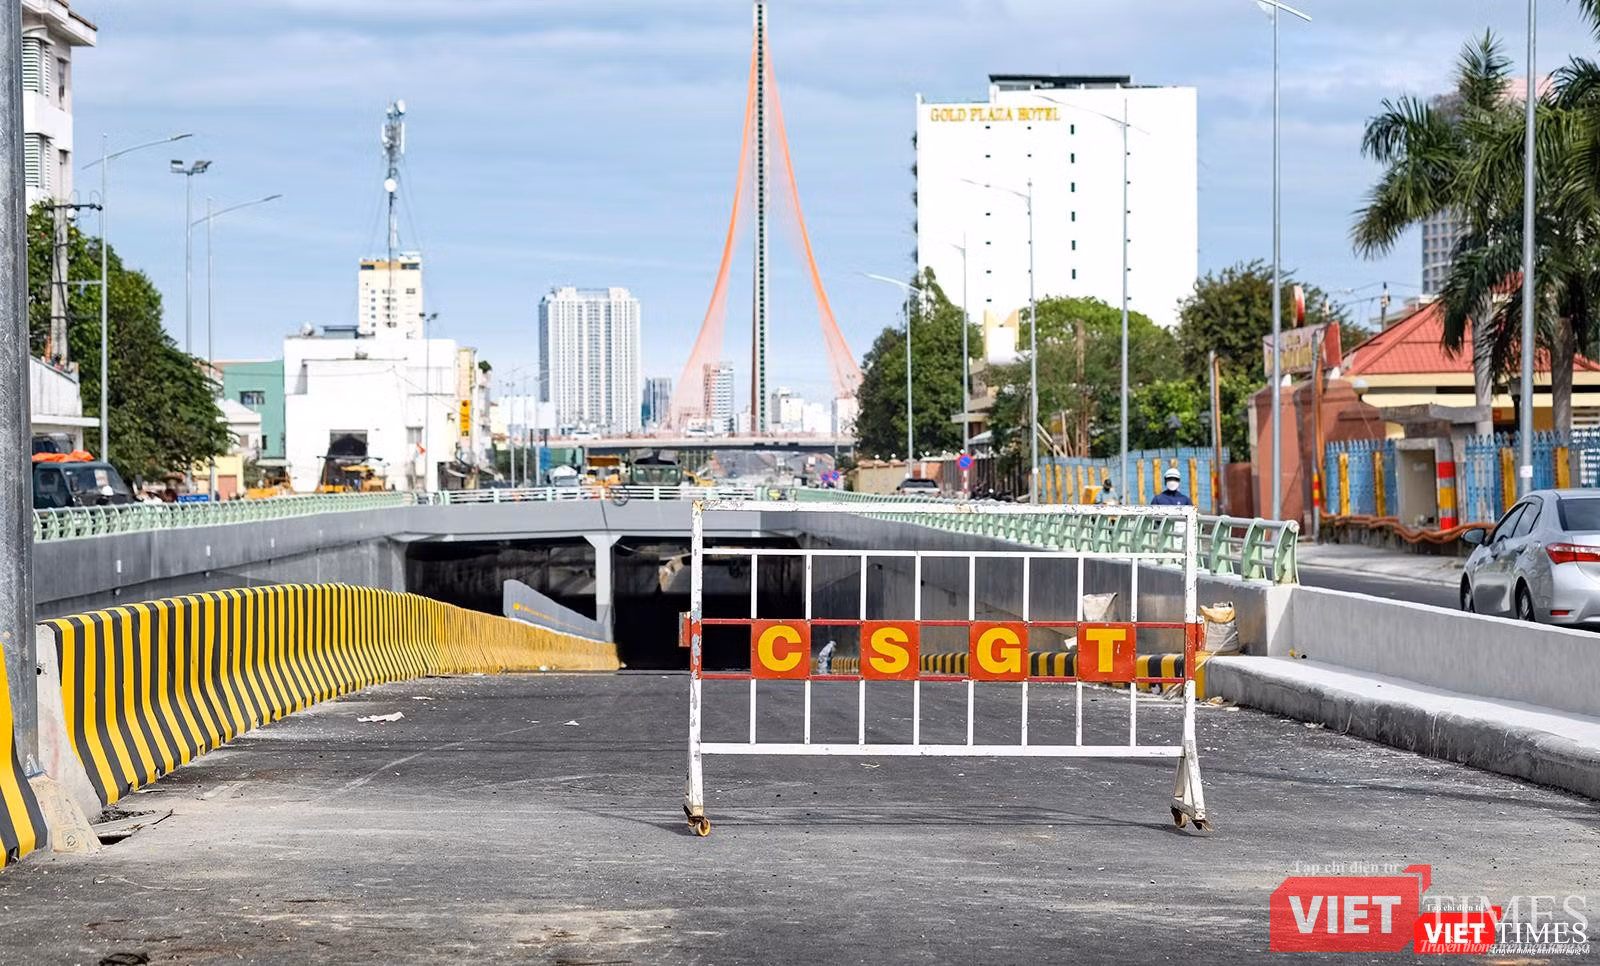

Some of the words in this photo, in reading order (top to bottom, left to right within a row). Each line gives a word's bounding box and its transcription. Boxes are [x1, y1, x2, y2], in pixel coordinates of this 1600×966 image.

[931, 108, 966, 122] GOLD
[969, 107, 1013, 122] PLAZA
[1018, 107, 1061, 121] HOTEL
